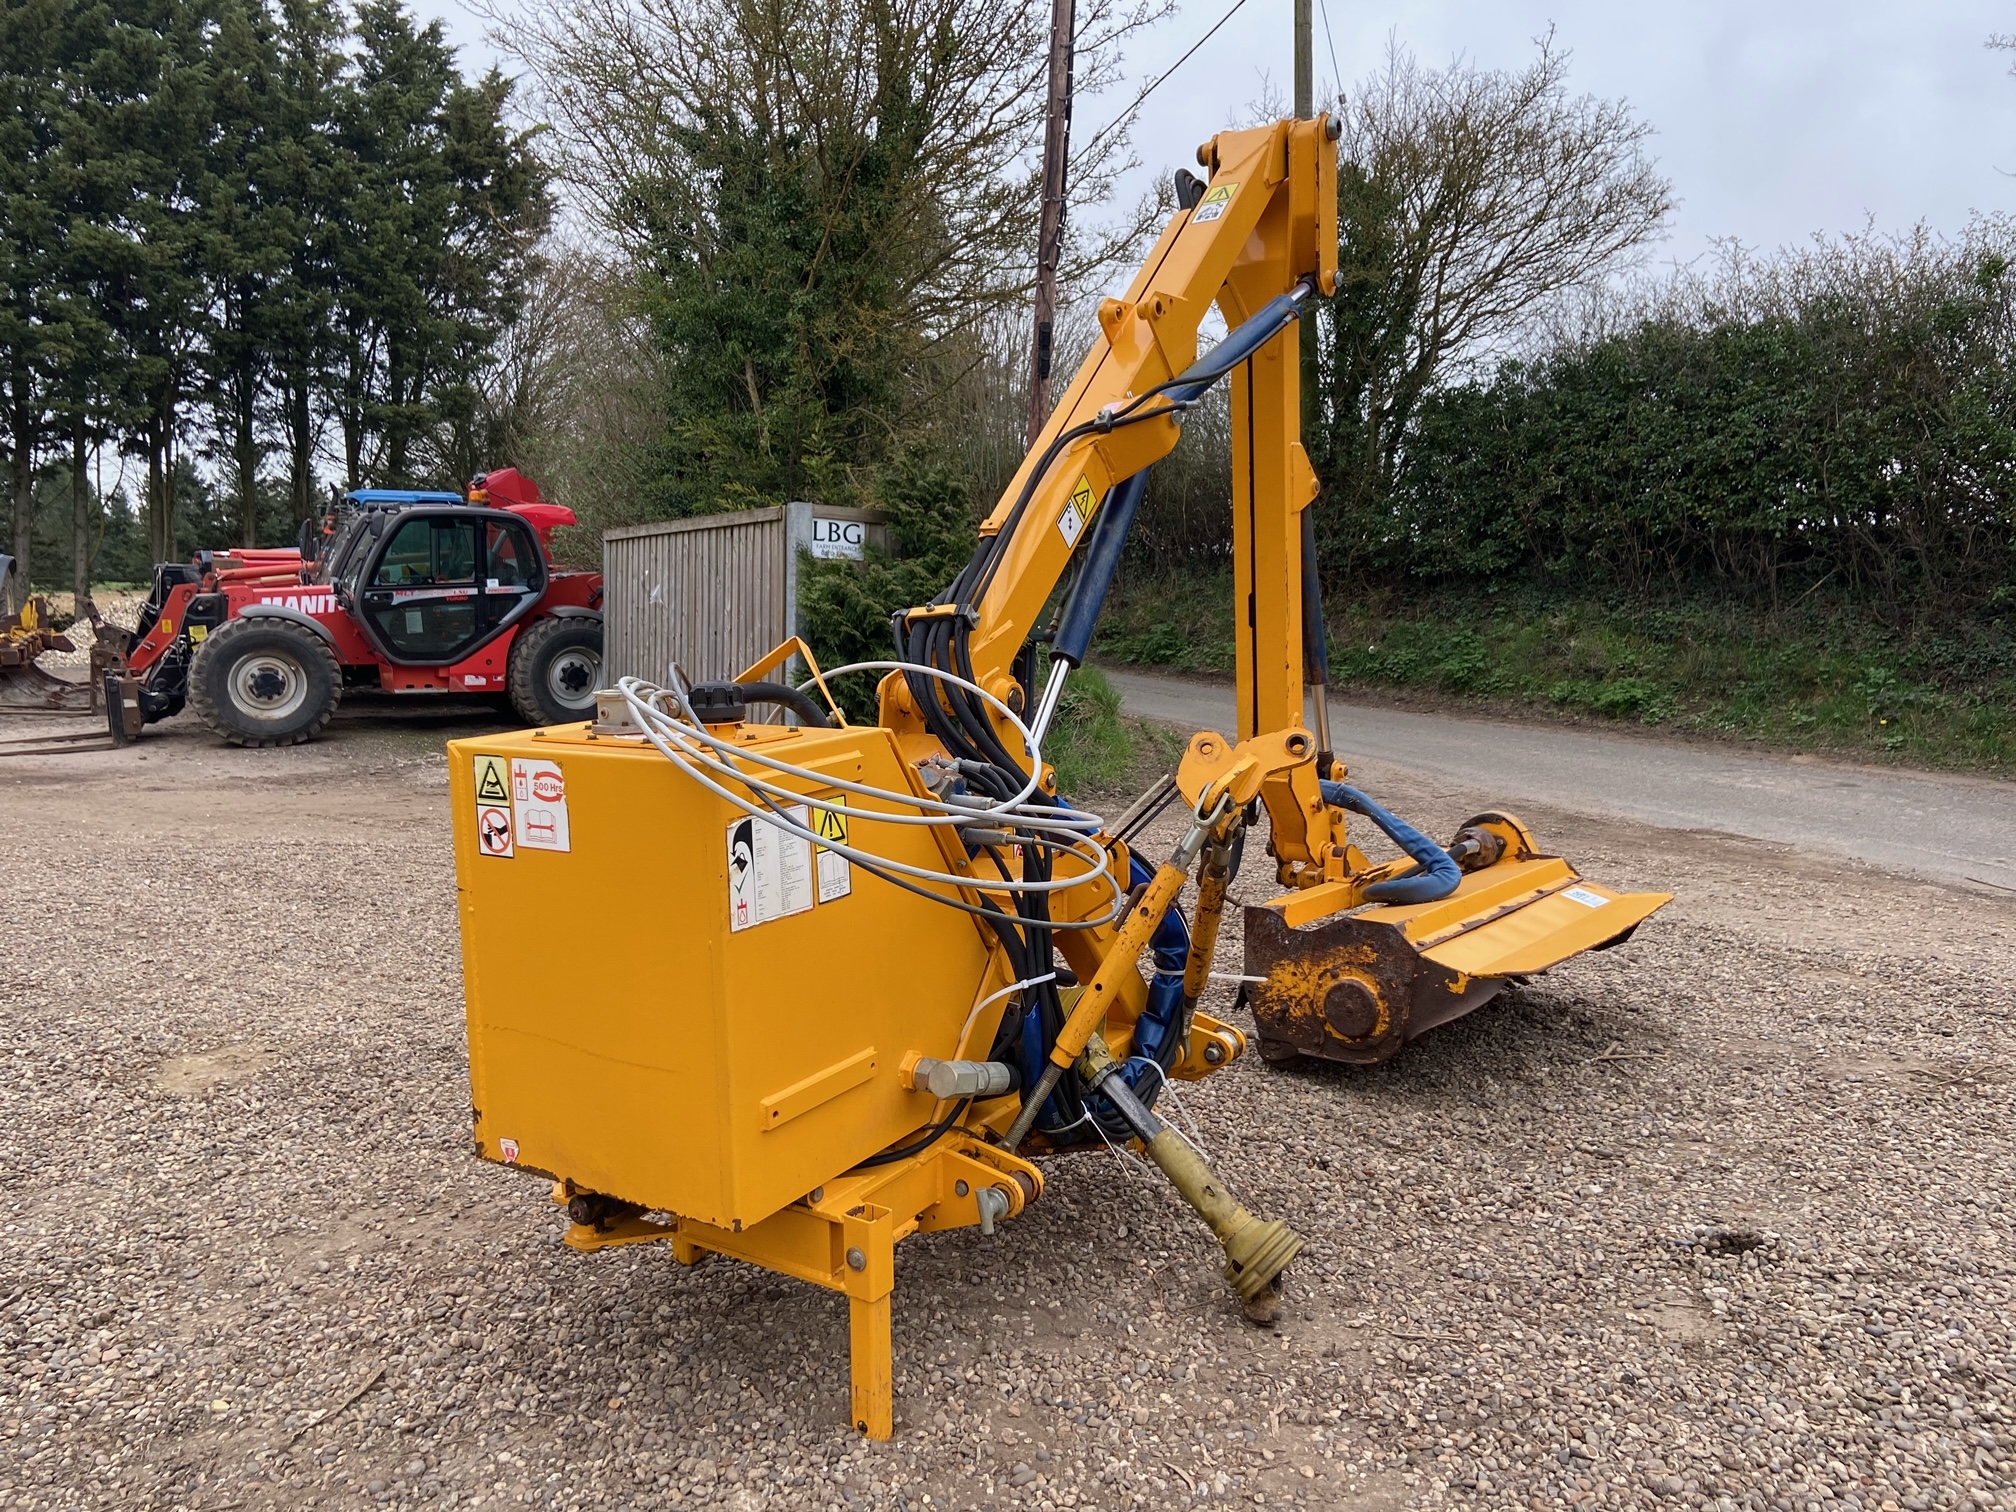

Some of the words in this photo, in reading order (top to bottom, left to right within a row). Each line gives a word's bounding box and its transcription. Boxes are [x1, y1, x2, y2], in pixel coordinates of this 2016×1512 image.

[813, 520, 861, 544] LBG
[534, 782, 549, 791] 500
[550, 783, 563, 793] Hrs
